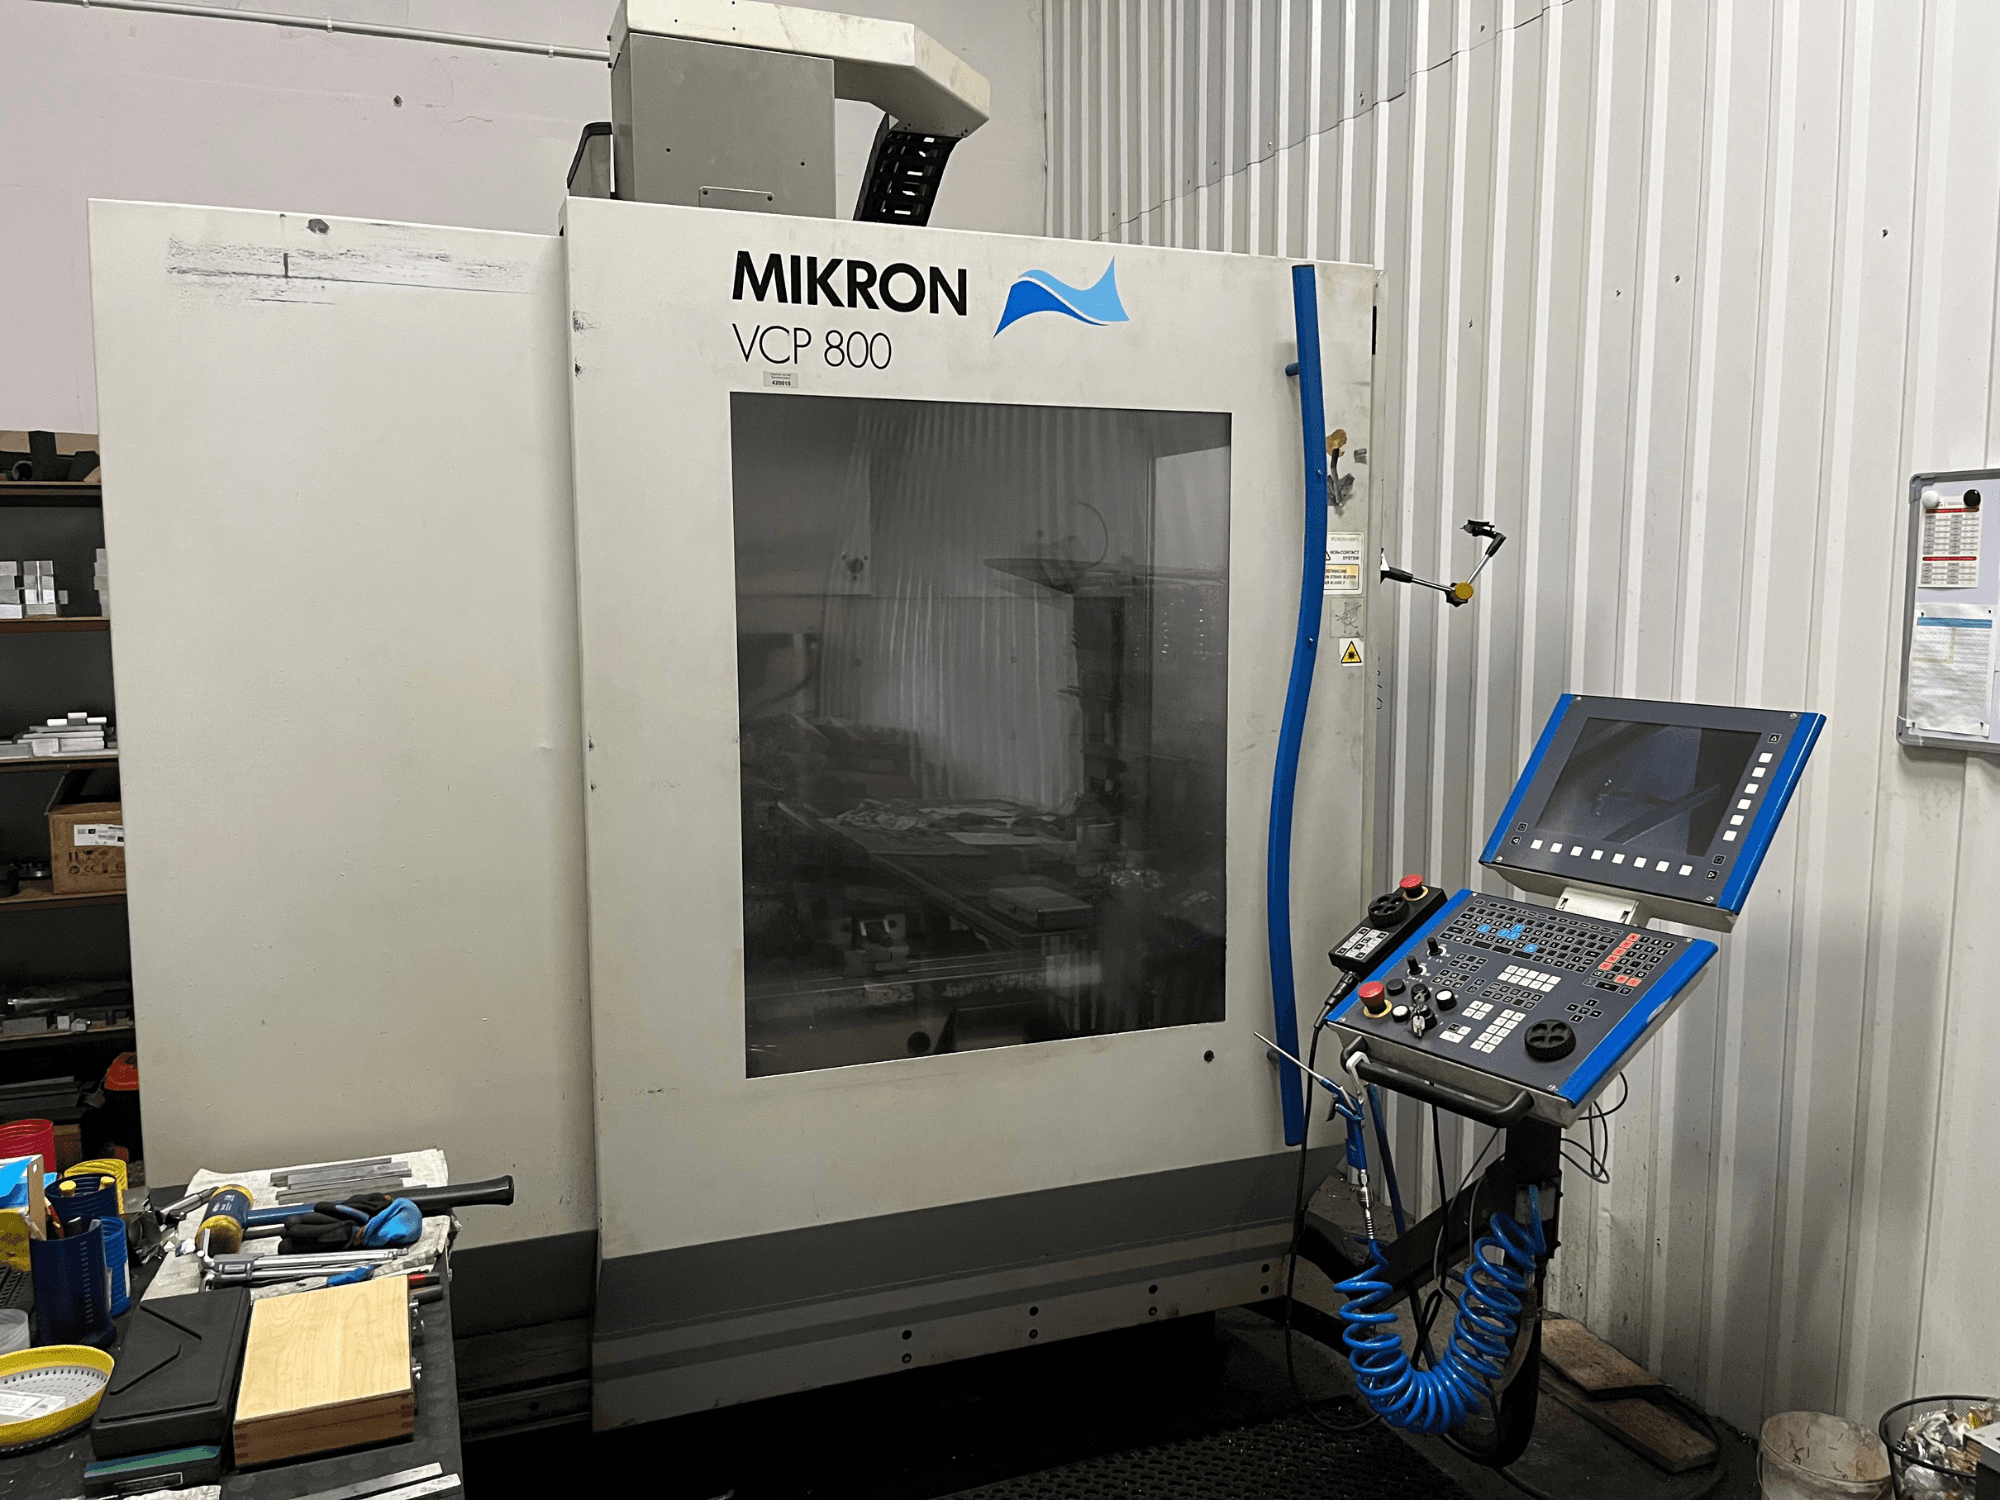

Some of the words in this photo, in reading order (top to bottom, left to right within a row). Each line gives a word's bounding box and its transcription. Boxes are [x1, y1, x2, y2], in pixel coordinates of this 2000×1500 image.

[732, 250, 967, 317] MIKRON
[732, 323, 812, 365] VCP
[824, 330, 891, 369] 800
